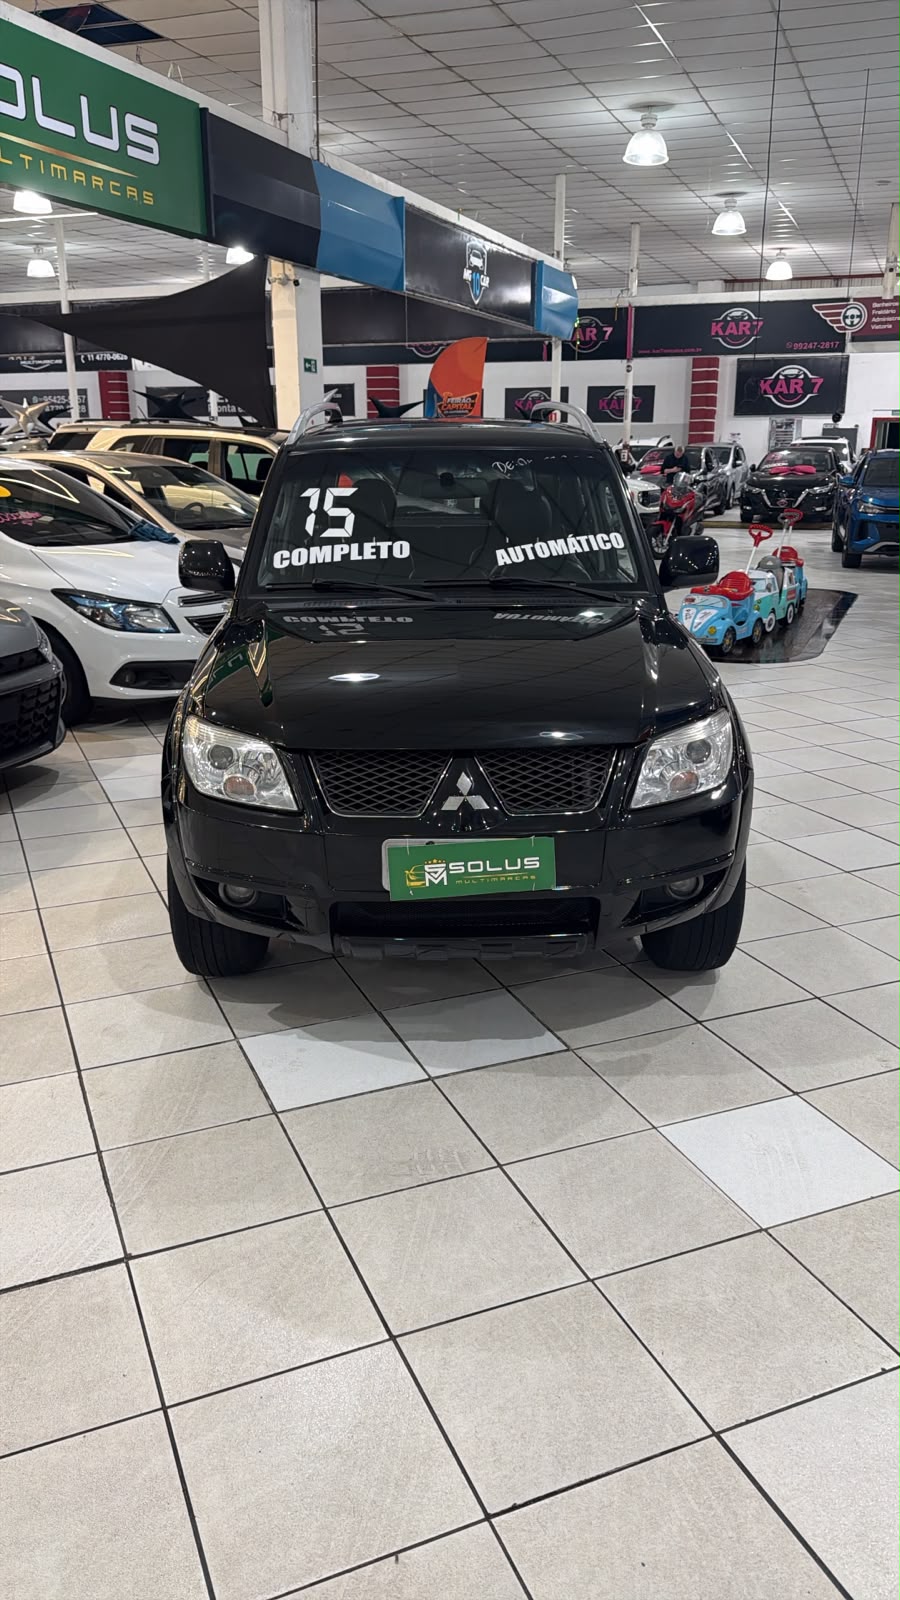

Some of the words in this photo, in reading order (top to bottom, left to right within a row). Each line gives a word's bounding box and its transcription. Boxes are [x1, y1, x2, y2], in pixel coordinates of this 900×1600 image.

[571, 327, 597, 341] AR
[603, 326, 614, 340] 7
[711, 321, 750, 336] KAR
[752, 320, 764, 336] 7
[793, 342, 840, 350] 99247-2817
[760, 378, 804, 394] KAR
[811, 377, 824, 393] 7
[299, 487, 360, 538] 15
[272, 540, 411, 569] COMPLETO
[496, 531, 625, 566] AUTOMÁTICO
[449, 857, 540, 874] SOLUS
[455, 875, 537, 885] MULTIMARCAS
